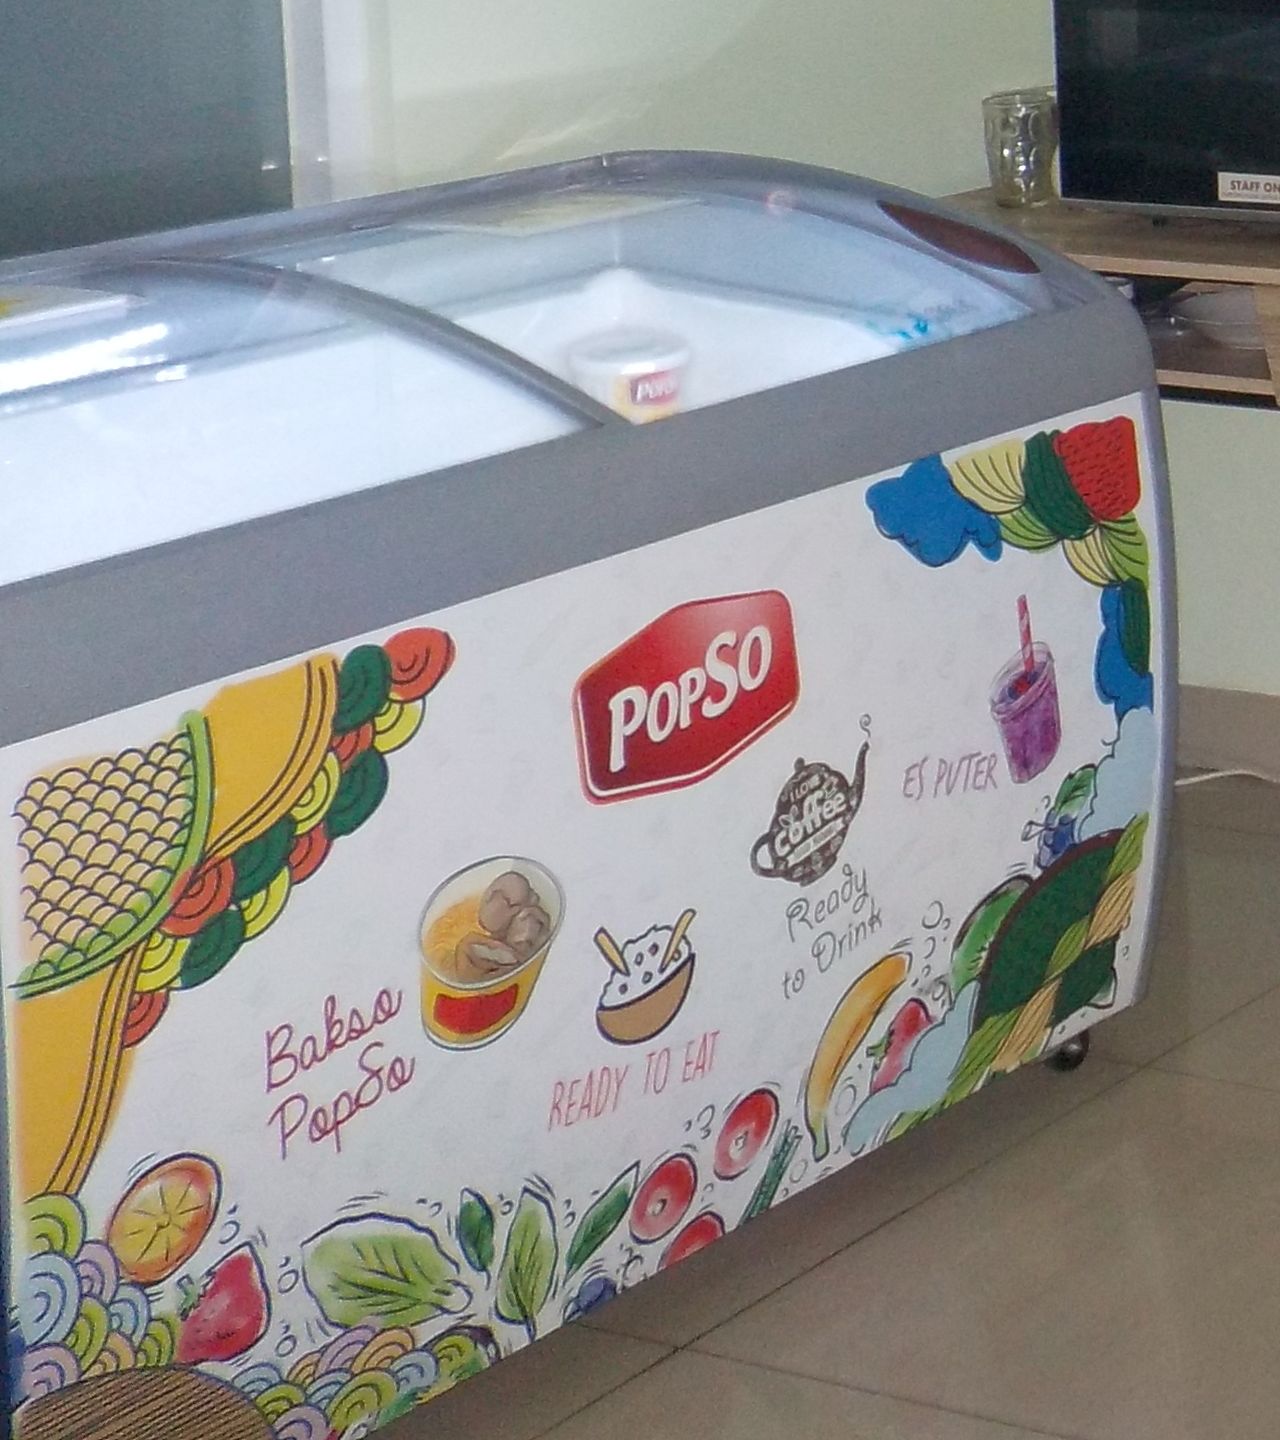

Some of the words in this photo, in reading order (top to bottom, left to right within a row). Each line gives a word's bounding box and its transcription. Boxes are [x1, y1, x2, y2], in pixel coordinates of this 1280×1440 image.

[1230, 180, 1260, 192] STAFF
[903, 755, 929, 801] ES
[933, 751, 998, 799] PUTER
[782, 968, 806, 1000] to
[811, 896, 883, 974] Drink
[786, 863, 870, 944] Ready
[266, 988, 403, 1094] Bakso
[548, 1064, 630, 1132] READY
[643, 1047, 672, 1096] TO
[681, 1029, 721, 1084] EAT
